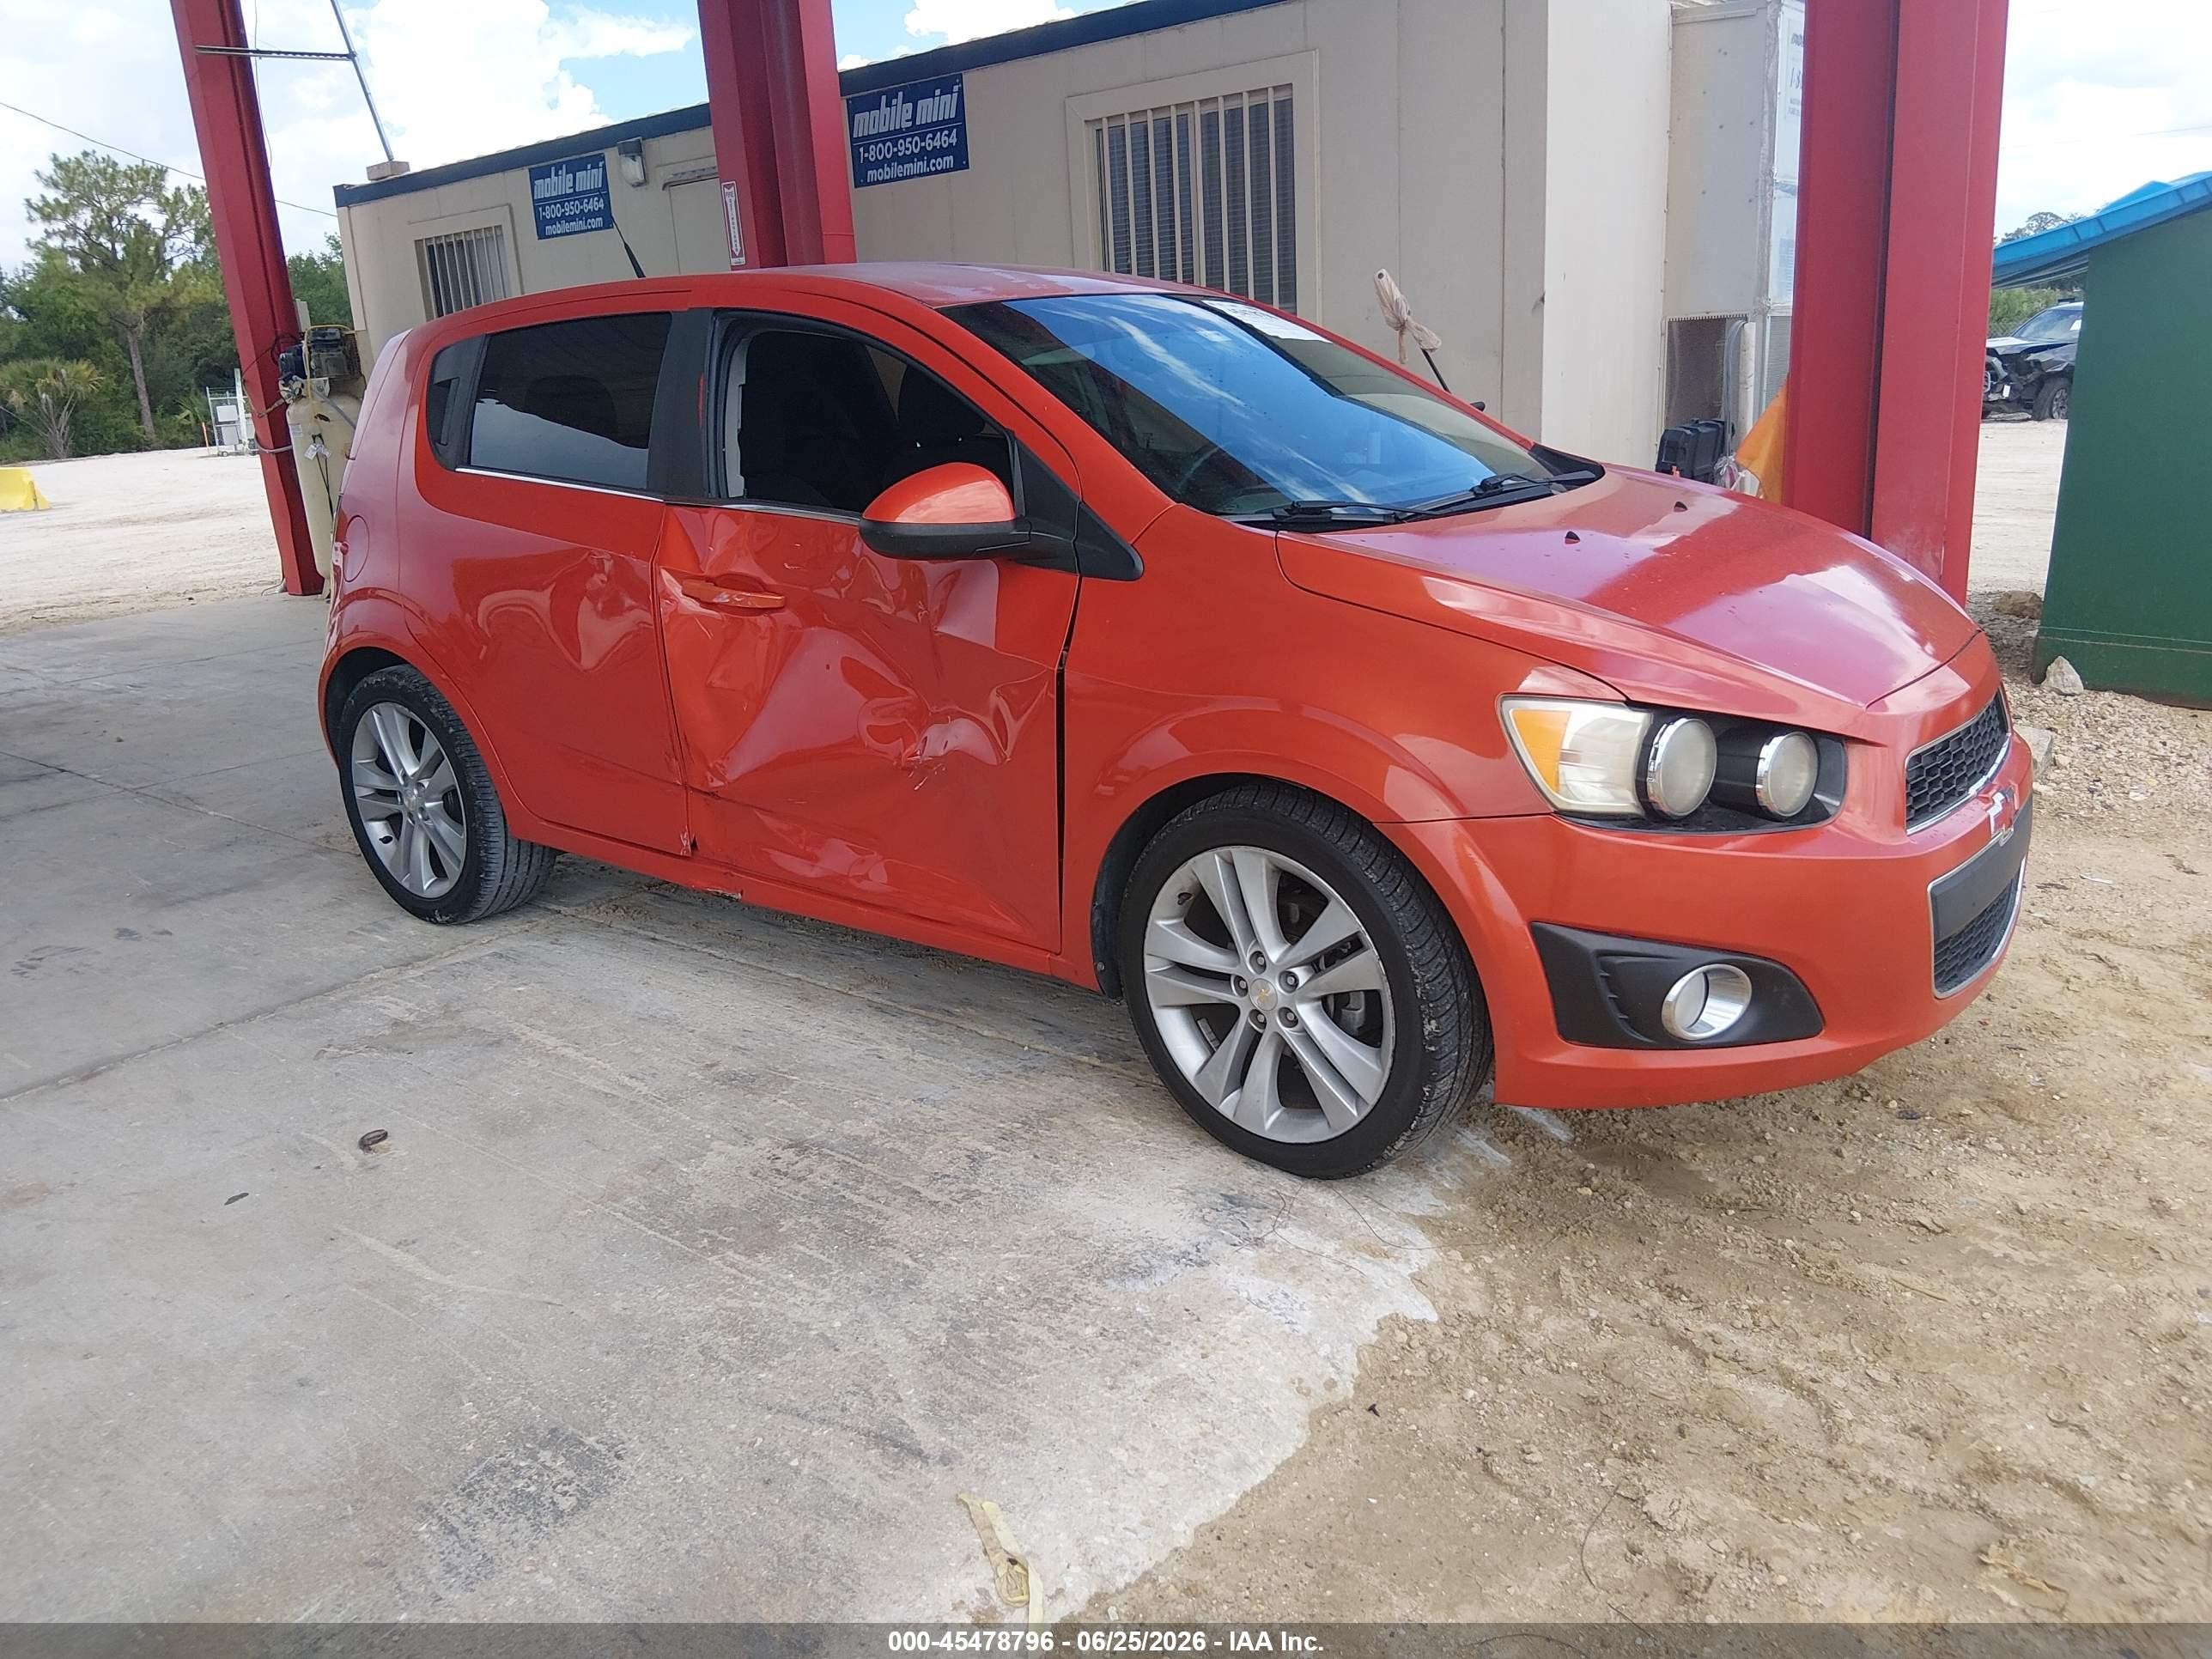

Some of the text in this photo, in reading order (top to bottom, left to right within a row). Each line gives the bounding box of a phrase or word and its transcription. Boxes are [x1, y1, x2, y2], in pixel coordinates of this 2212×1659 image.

[854, 85, 958, 137] mobile mini
[860, 129, 957, 163] 1-800-950-6464
[534, 163, 604, 199] mobile mini
[866, 155, 954, 183] mobilemini.com
[538, 197, 605, 220] 1-800-950-6464
[545, 216, 604, 236] mobilemini.com
